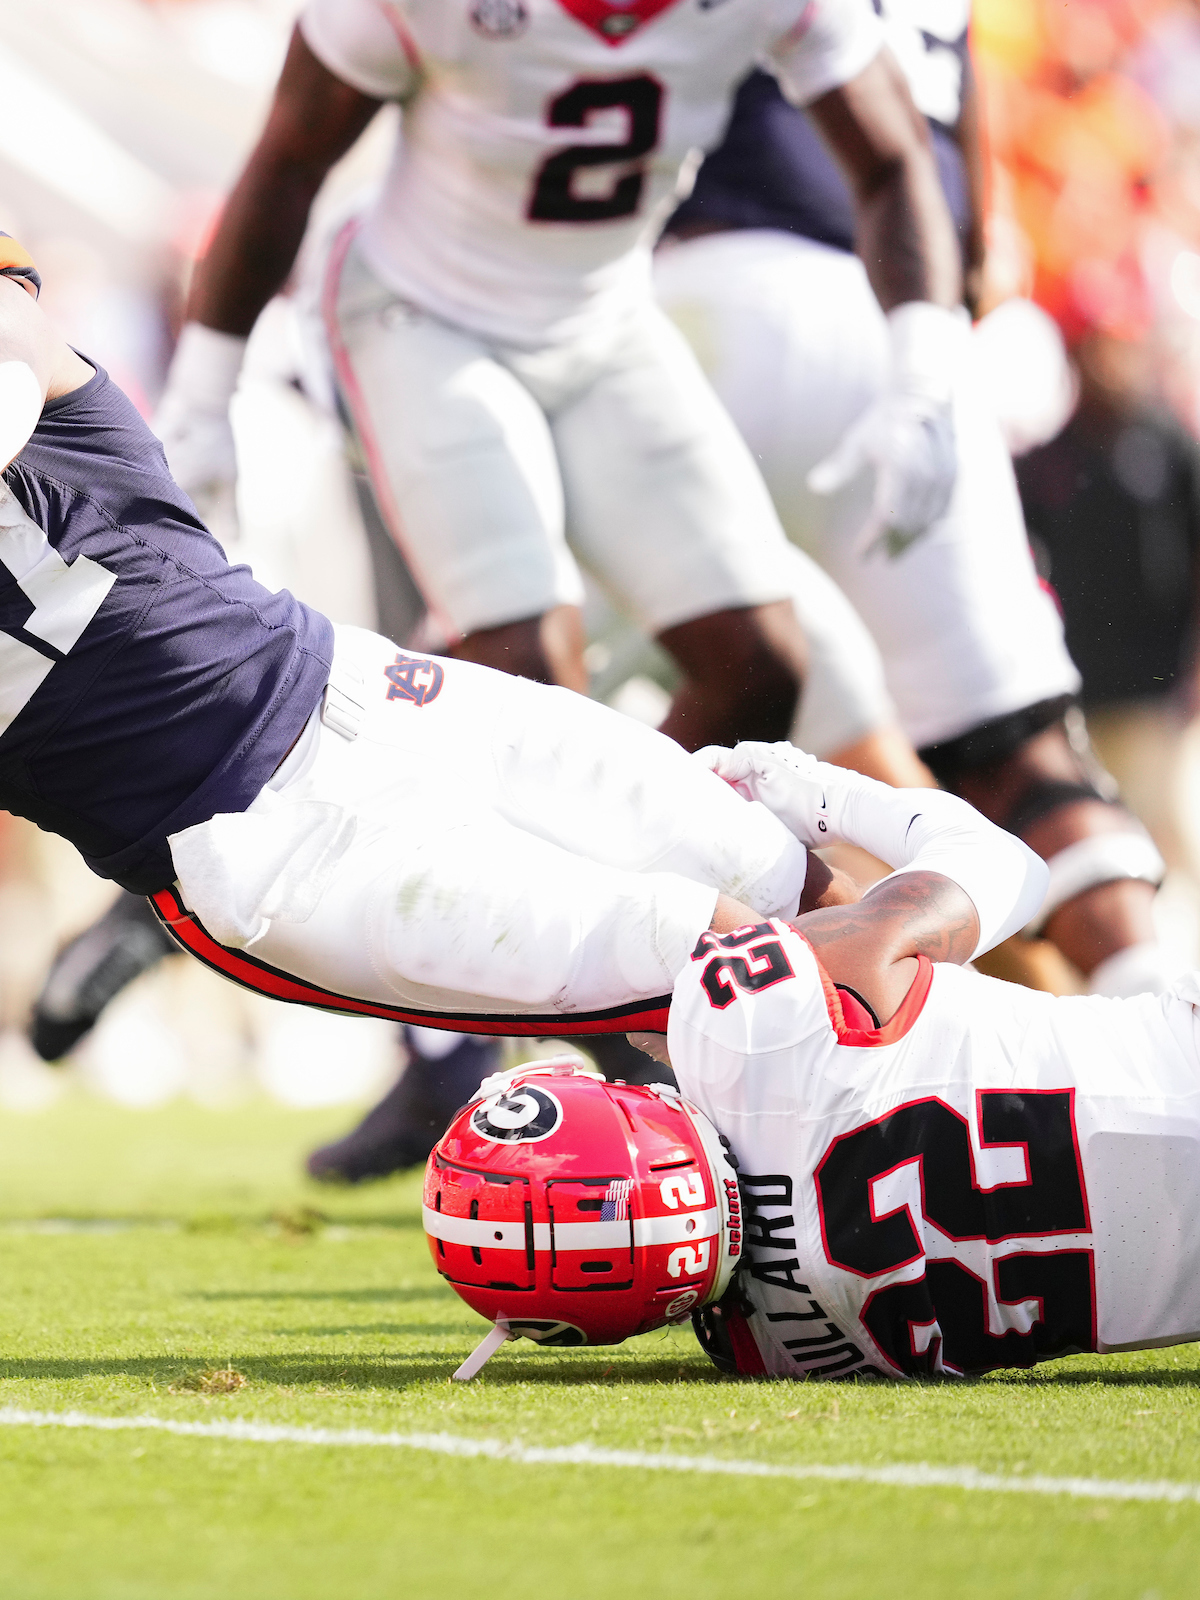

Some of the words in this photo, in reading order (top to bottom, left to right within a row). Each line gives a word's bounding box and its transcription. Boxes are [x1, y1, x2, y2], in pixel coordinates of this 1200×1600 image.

[527, 71, 667, 223] 2
[690, 920, 796, 1010] 22
[659, 1172, 711, 1279] 22
[722, 1178, 742, 1257] schutt
[740, 1174, 882, 1380] ULLARD
[812, 1087, 1098, 1380] 22
